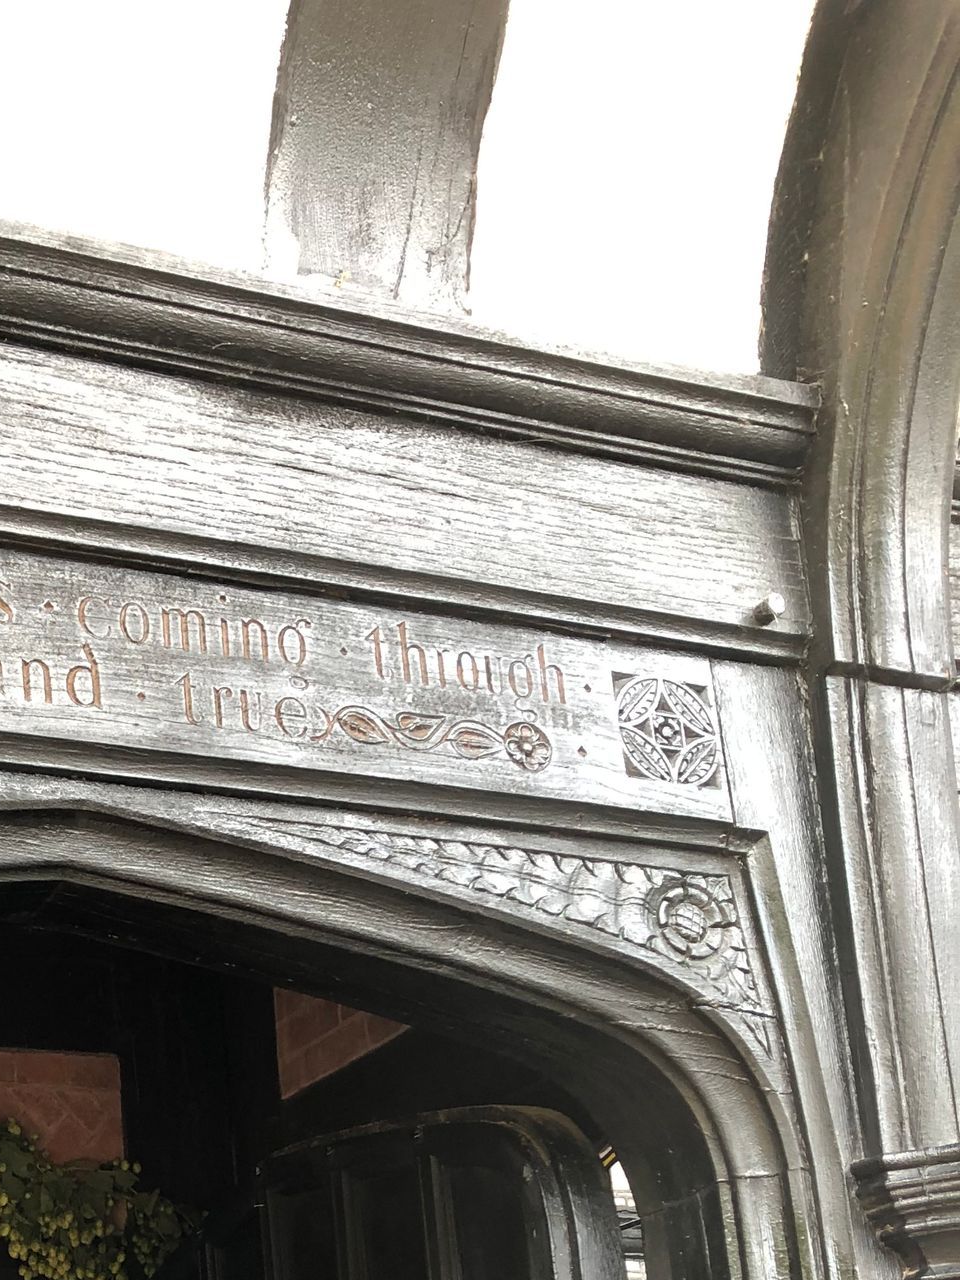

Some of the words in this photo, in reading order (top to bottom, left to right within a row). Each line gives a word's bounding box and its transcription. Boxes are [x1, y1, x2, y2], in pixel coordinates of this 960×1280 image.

[77, 594, 312, 691] coming
[364, 620, 567, 723] through
[174, 671, 310, 739] true
